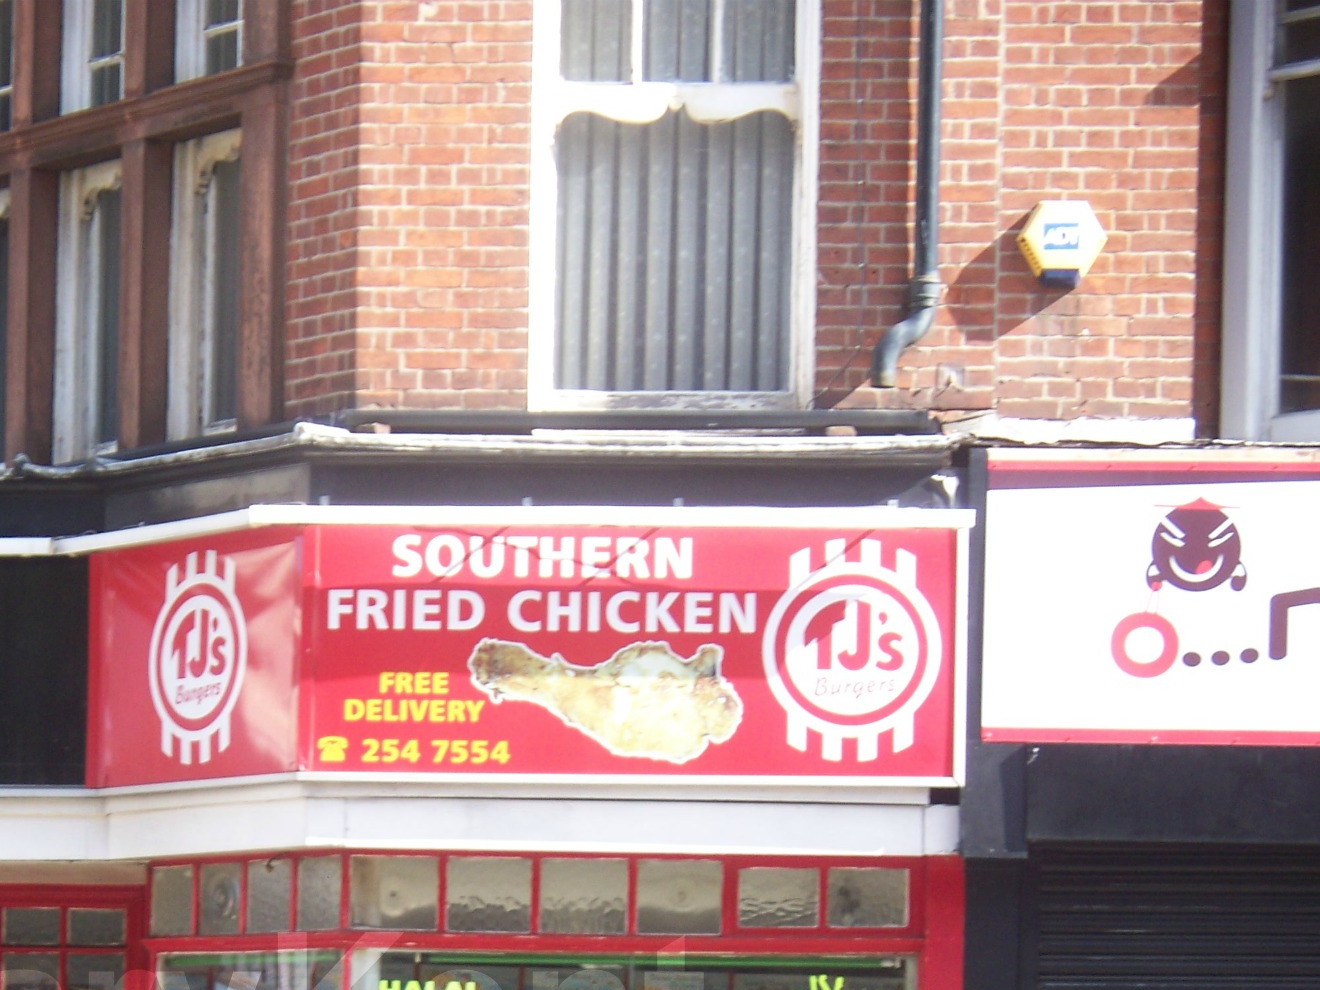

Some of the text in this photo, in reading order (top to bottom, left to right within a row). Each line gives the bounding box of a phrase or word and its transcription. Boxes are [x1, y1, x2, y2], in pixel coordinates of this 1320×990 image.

[391, 533, 694, 579] SOUTHERN
[327, 588, 758, 633] FRIED CHICKEN
[174, 682, 222, 705] Burgers
[379, 672, 450, 696] FREE
[814, 676, 896, 699] Burgers
[343, 699, 486, 723] DELIVERY
[361, 739, 511, 765] 254 7554
